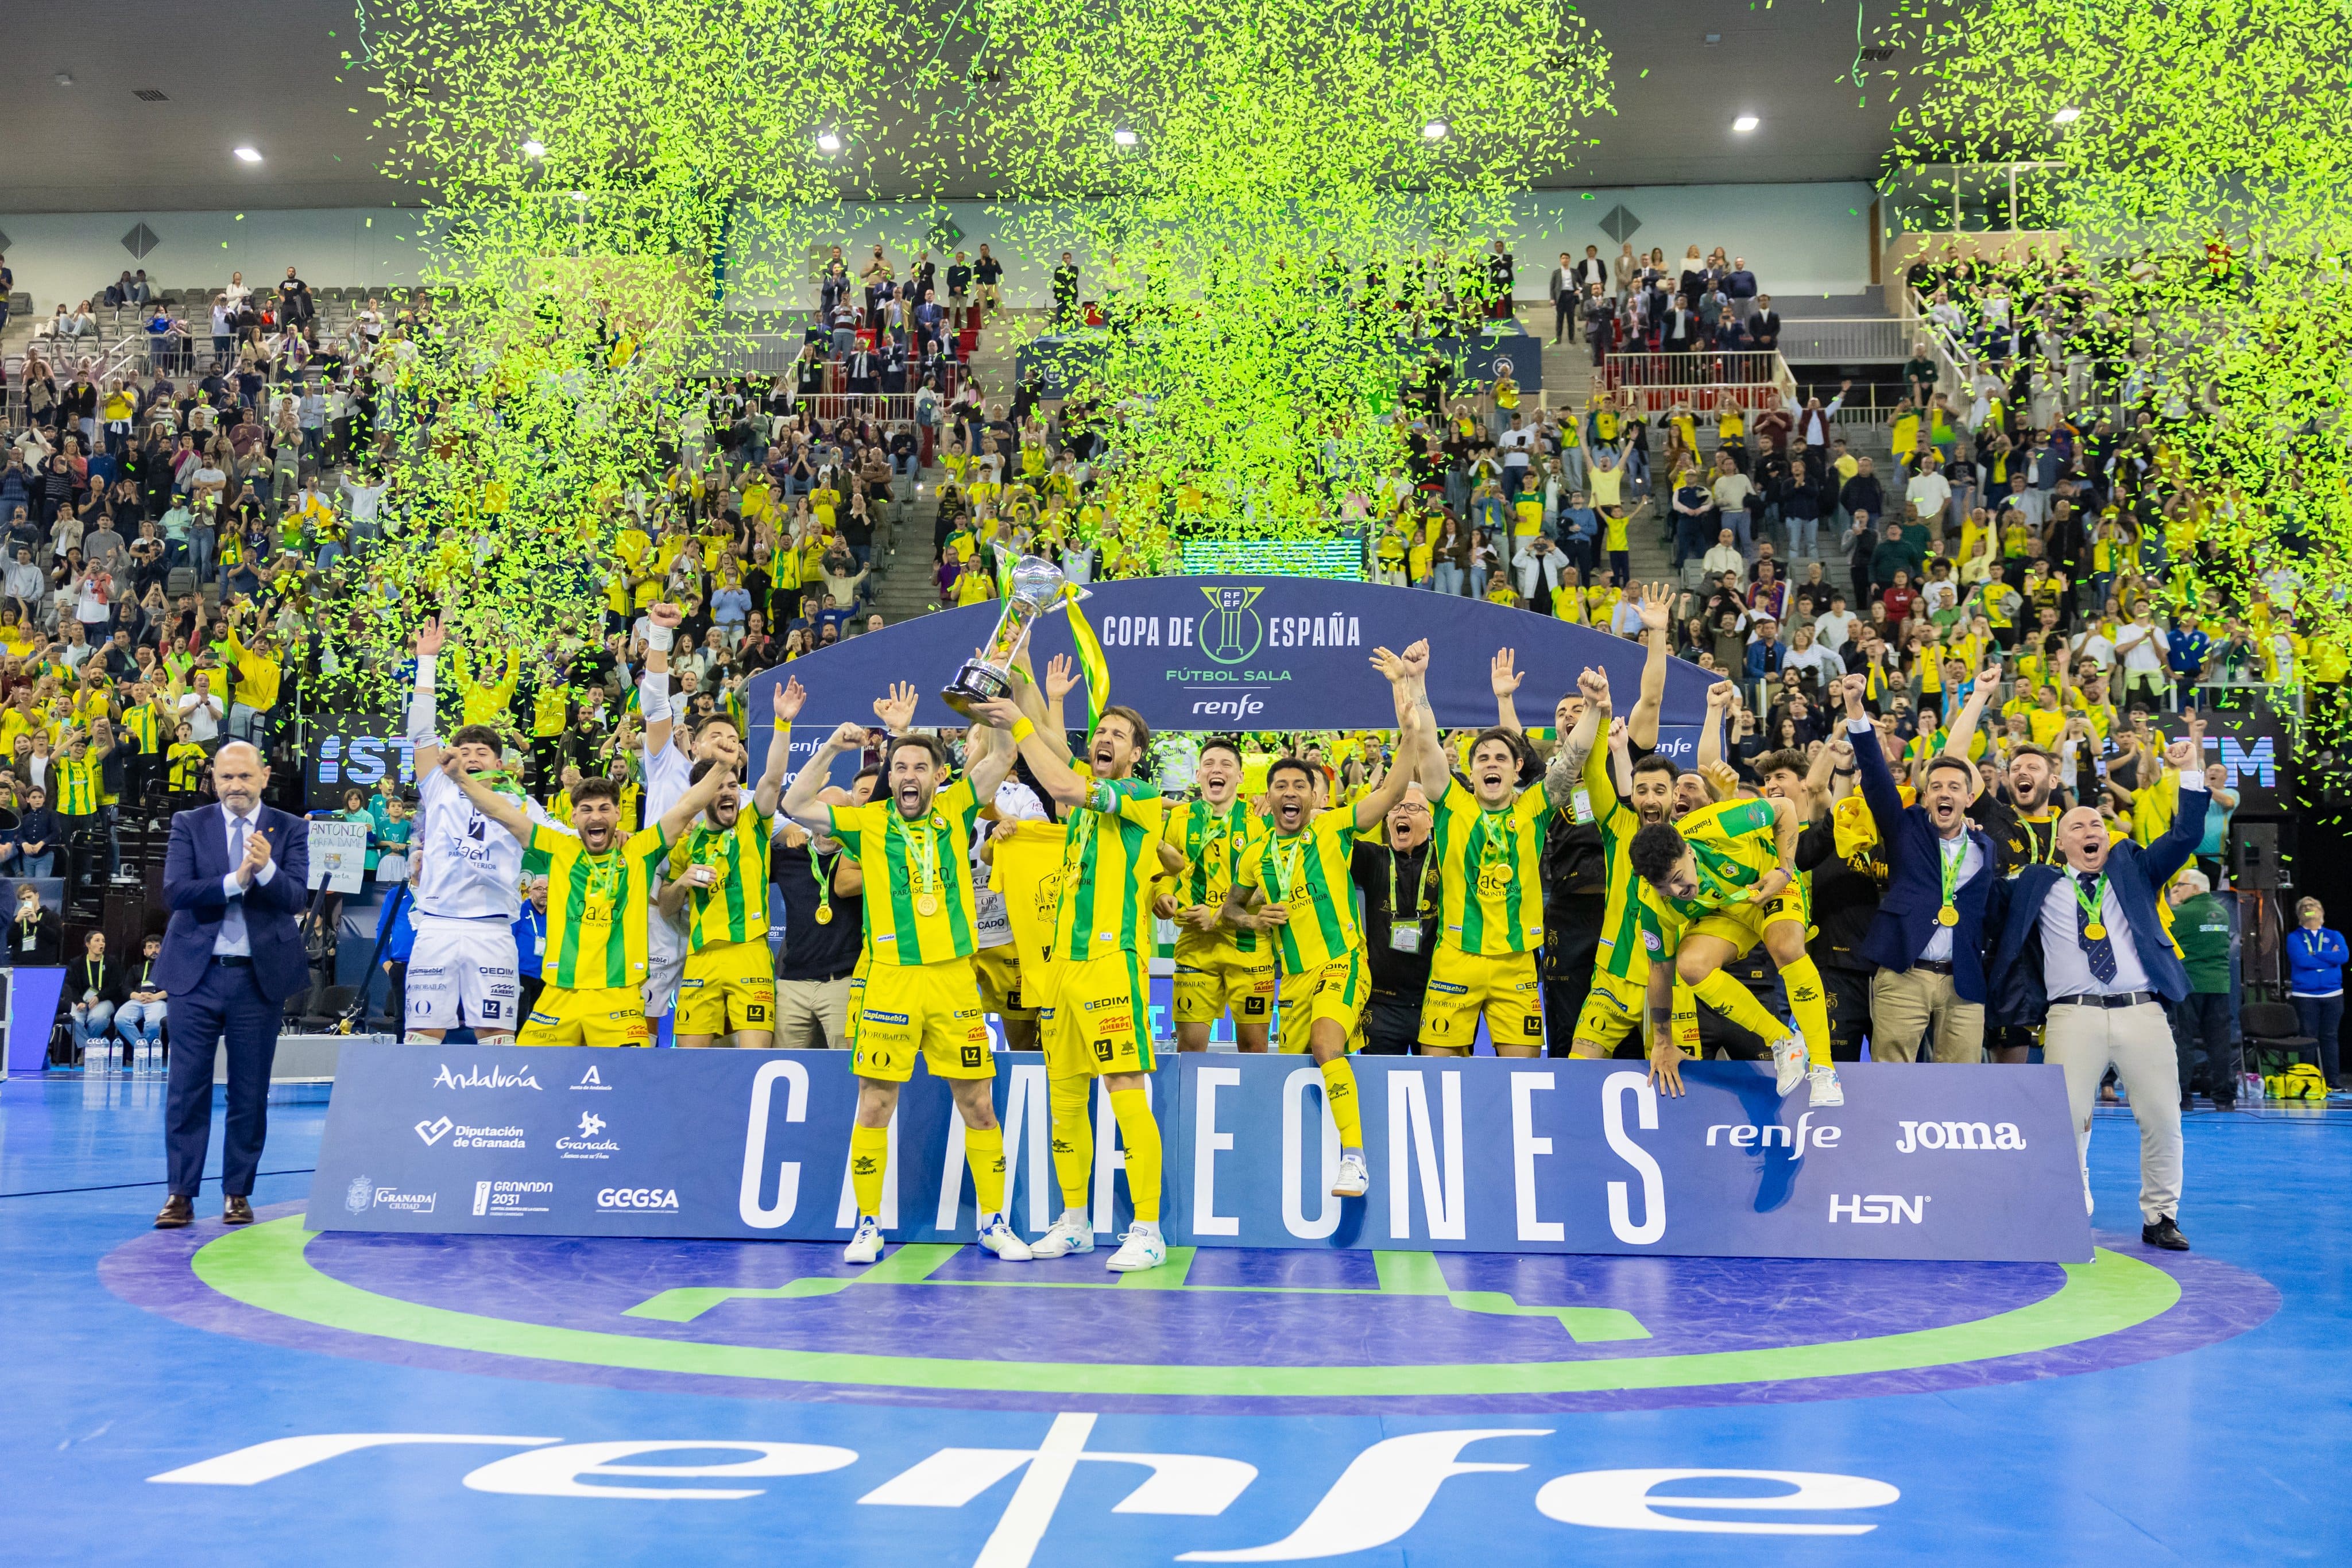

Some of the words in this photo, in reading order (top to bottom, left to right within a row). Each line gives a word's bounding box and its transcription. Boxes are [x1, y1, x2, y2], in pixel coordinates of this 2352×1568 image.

[1103, 616, 1160, 646] COPA
[1168, 617, 1194, 647] DE
[1269, 611, 1360, 647] ESPAÑA
[1166, 667, 1239, 682] FÚTBOL
[1243, 670, 1292, 682] SALA
[1192, 694, 1264, 721] renfe
[789, 737, 827, 757] enf
[1654, 737, 1692, 758] enfe
[310, 823, 366, 838] ANTONIO
[1289, 882, 1318, 904] aén
[479, 967, 514, 975] OEDIM
[1516, 982, 1538, 990] OED
[484, 1002, 497, 1013] LZ
[1084, 996, 1129, 1011] OEDIM
[1248, 999, 1261, 1009] LZ
[749, 1006, 762, 1017] LZ
[863, 1011, 907, 1023] Rapimueble
[1100, 1021, 1129, 1032] JAHERPE
[1528, 1019, 1540, 1030] LZ
[965, 1050, 978, 1061] LZ
[1096, 1043, 1109, 1057] LZ
[433, 1063, 543, 1091] Andalucía
[455, 1125, 524, 1139] Diputación
[1706, 1112, 1842, 1160] renfe
[452, 1136, 470, 1148] de
[471, 1136, 526, 1149] Granada
[555, 1136, 621, 1151] Granada
[494, 1180, 554, 1193] GRANADA
[377, 1190, 432, 1205] GRANADA
[492, 1193, 520, 1206] 2031
[389, 1202, 420, 1210] CIUDAD
[145, 1429, 1902, 1562] renfe
